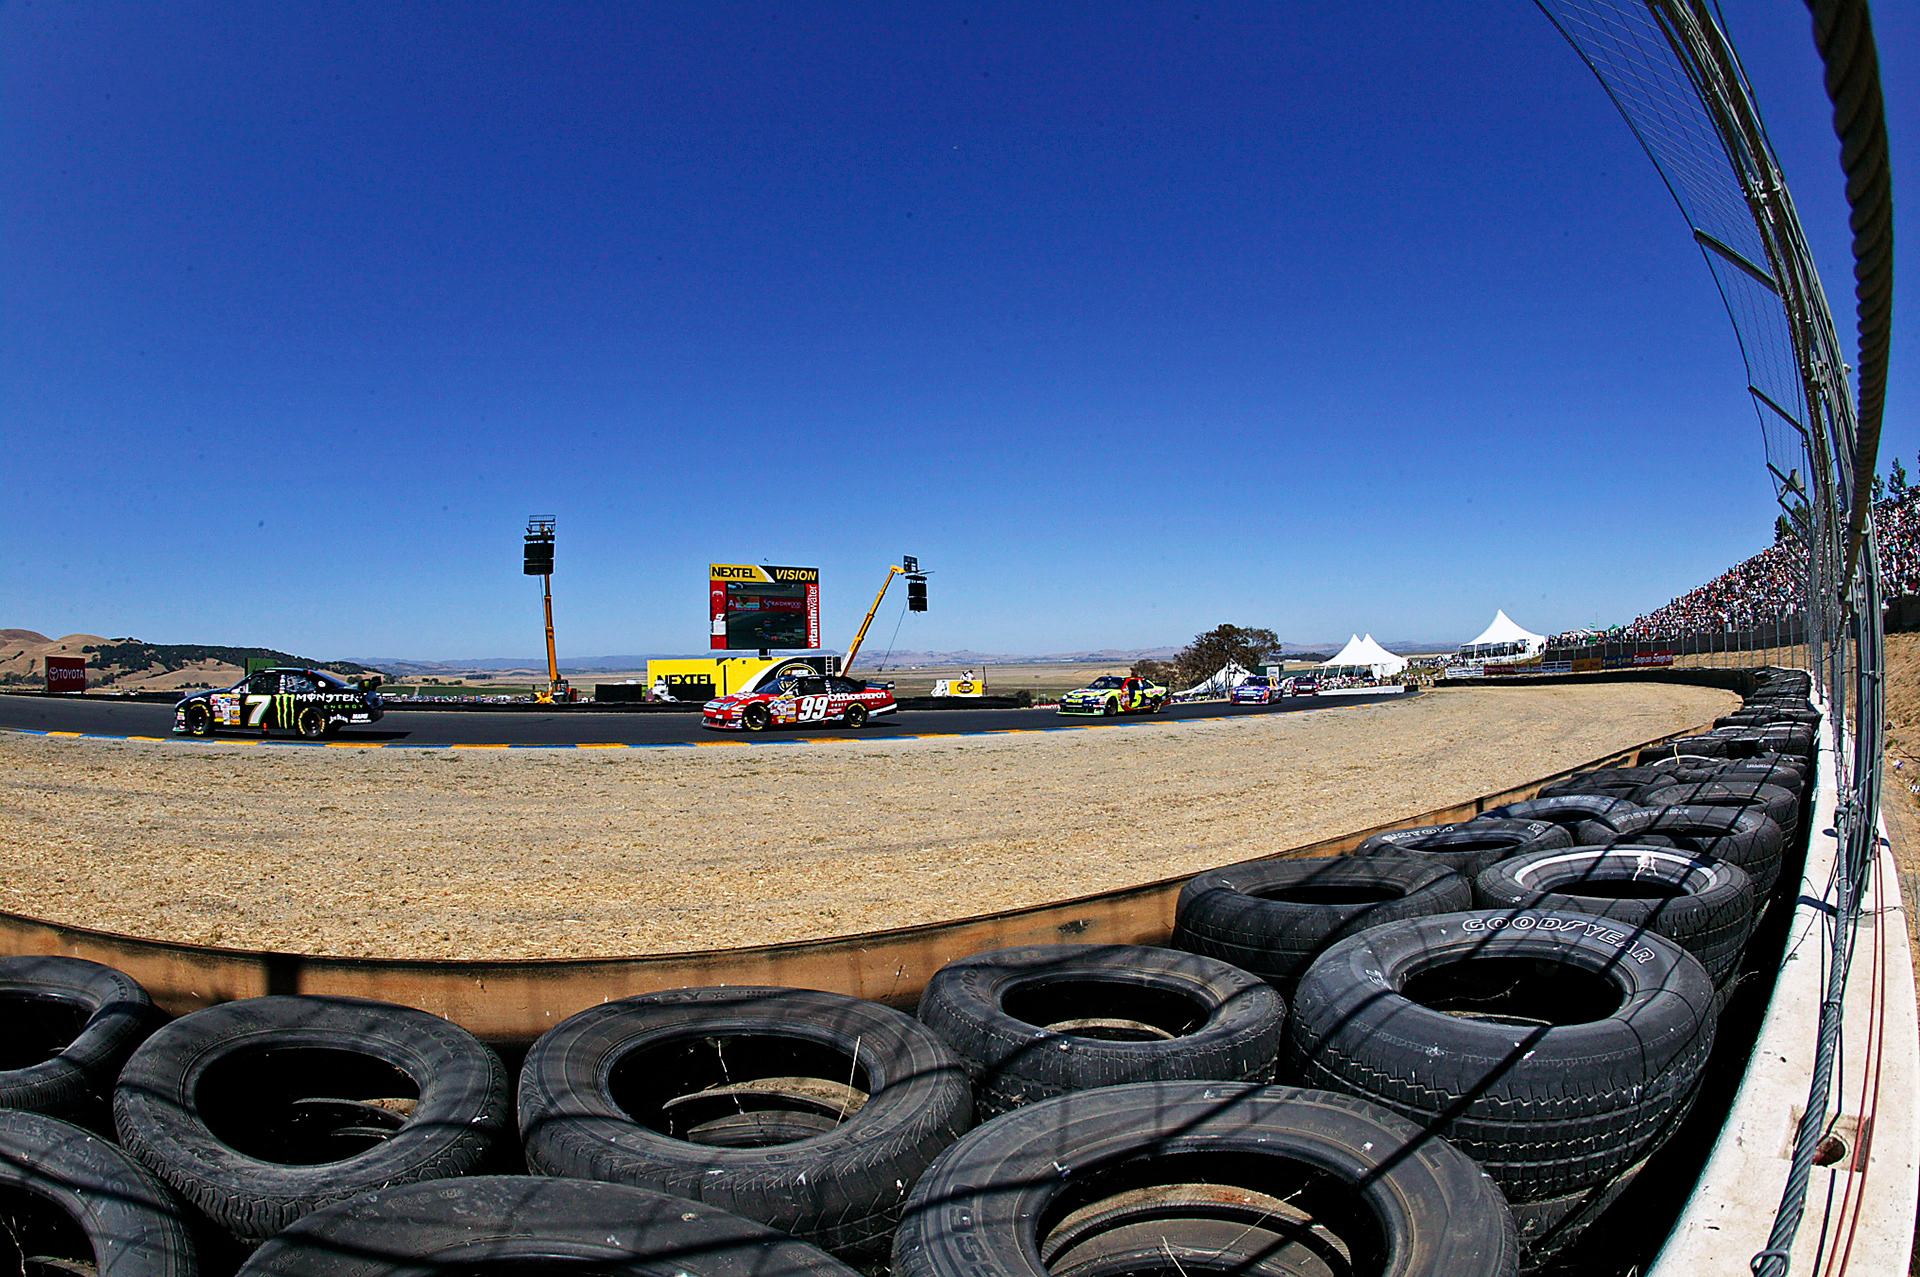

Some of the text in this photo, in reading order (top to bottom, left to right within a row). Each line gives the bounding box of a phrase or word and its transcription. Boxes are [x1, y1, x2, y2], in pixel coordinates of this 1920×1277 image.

[712, 566, 816, 581] NEXTEL VISION
[808, 585, 818, 648] vitaminwater
[59, 668, 84, 679] TOYOTA
[657, 674, 712, 685] NEXTEL
[245, 695, 272, 726] 7
[800, 697, 828, 721] 99
[1131, 690, 1143, 708] 5
[1462, 917, 1656, 965] GOODYEAR
[1220, 1088, 1446, 1170] GENERAL
